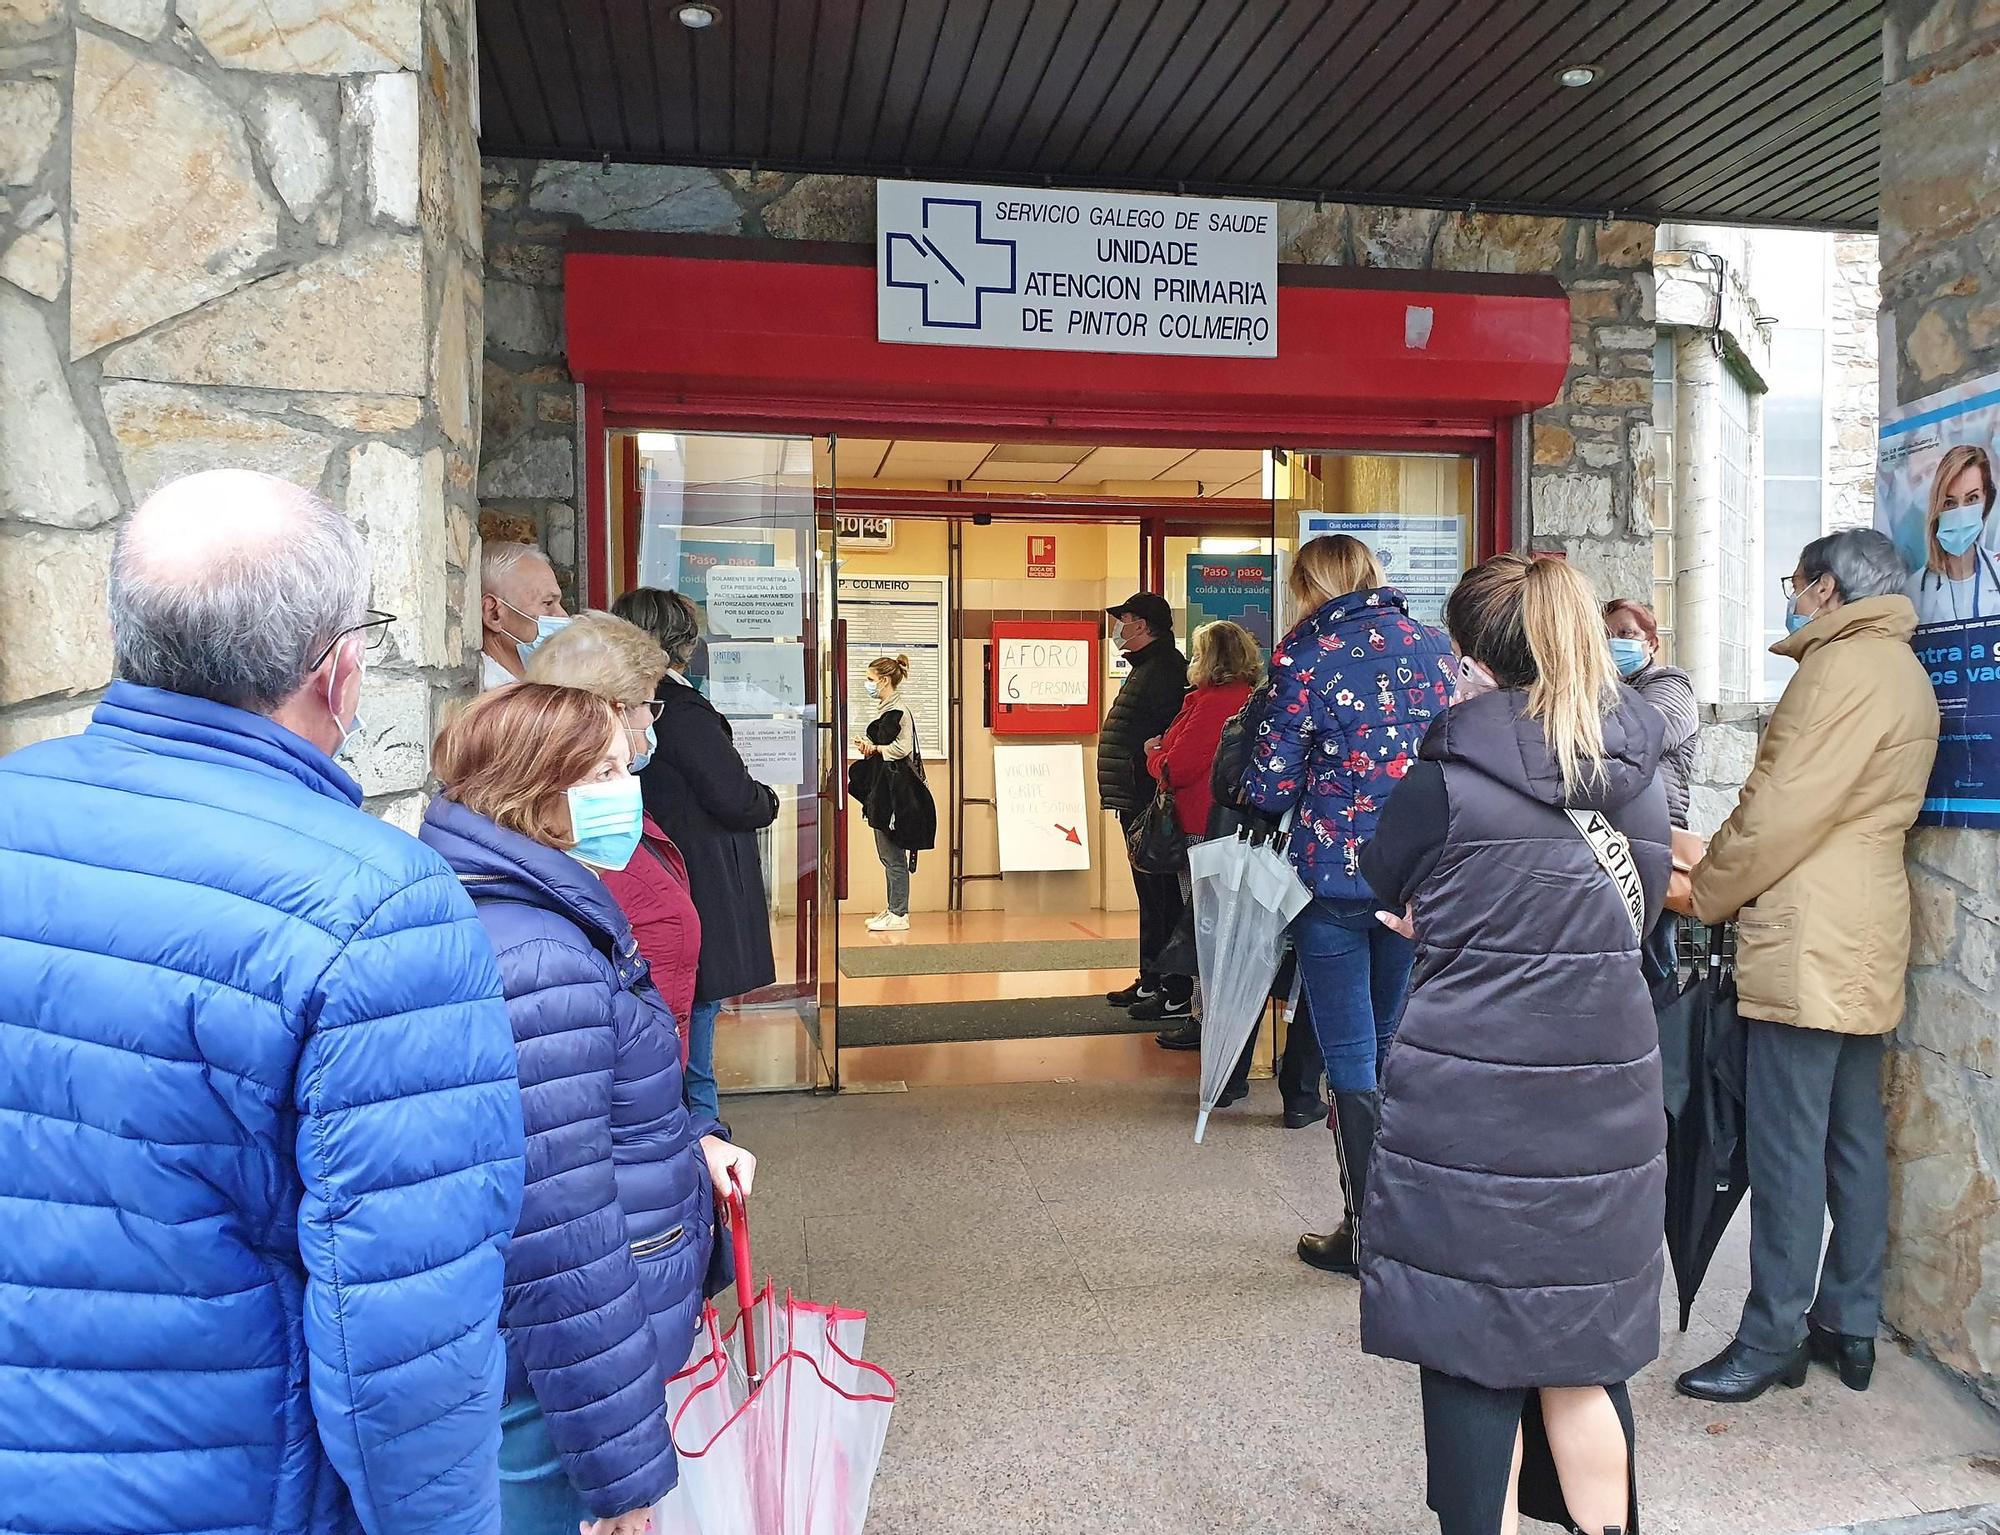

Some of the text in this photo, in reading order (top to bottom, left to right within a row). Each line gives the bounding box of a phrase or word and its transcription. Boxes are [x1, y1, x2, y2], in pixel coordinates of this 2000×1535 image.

[995, 201, 1268, 234] SERVICIO GALEGO DE SAUDE
[1097, 238, 1198, 266] UNIDADE
[1024, 272, 1267, 305] ATENCION PRIMARIA
[1022, 308, 1269, 341] DE PINTOR COLMEIRO
[840, 517, 886, 533] 10 46
[689, 554, 717, 565] Paso
[1203, 566, 1228, 577] Paso
[1237, 568, 1263, 579] paso
[852, 579, 910, 591] COLMEIRO
[1195, 585, 1218, 594] coida
[1004, 645, 1078, 668] AFORO
[1970, 644, 1985, 659] a
[1007, 673, 1087, 699] 6 PERSONAS
[1320, 671, 1344, 696] LOVE
